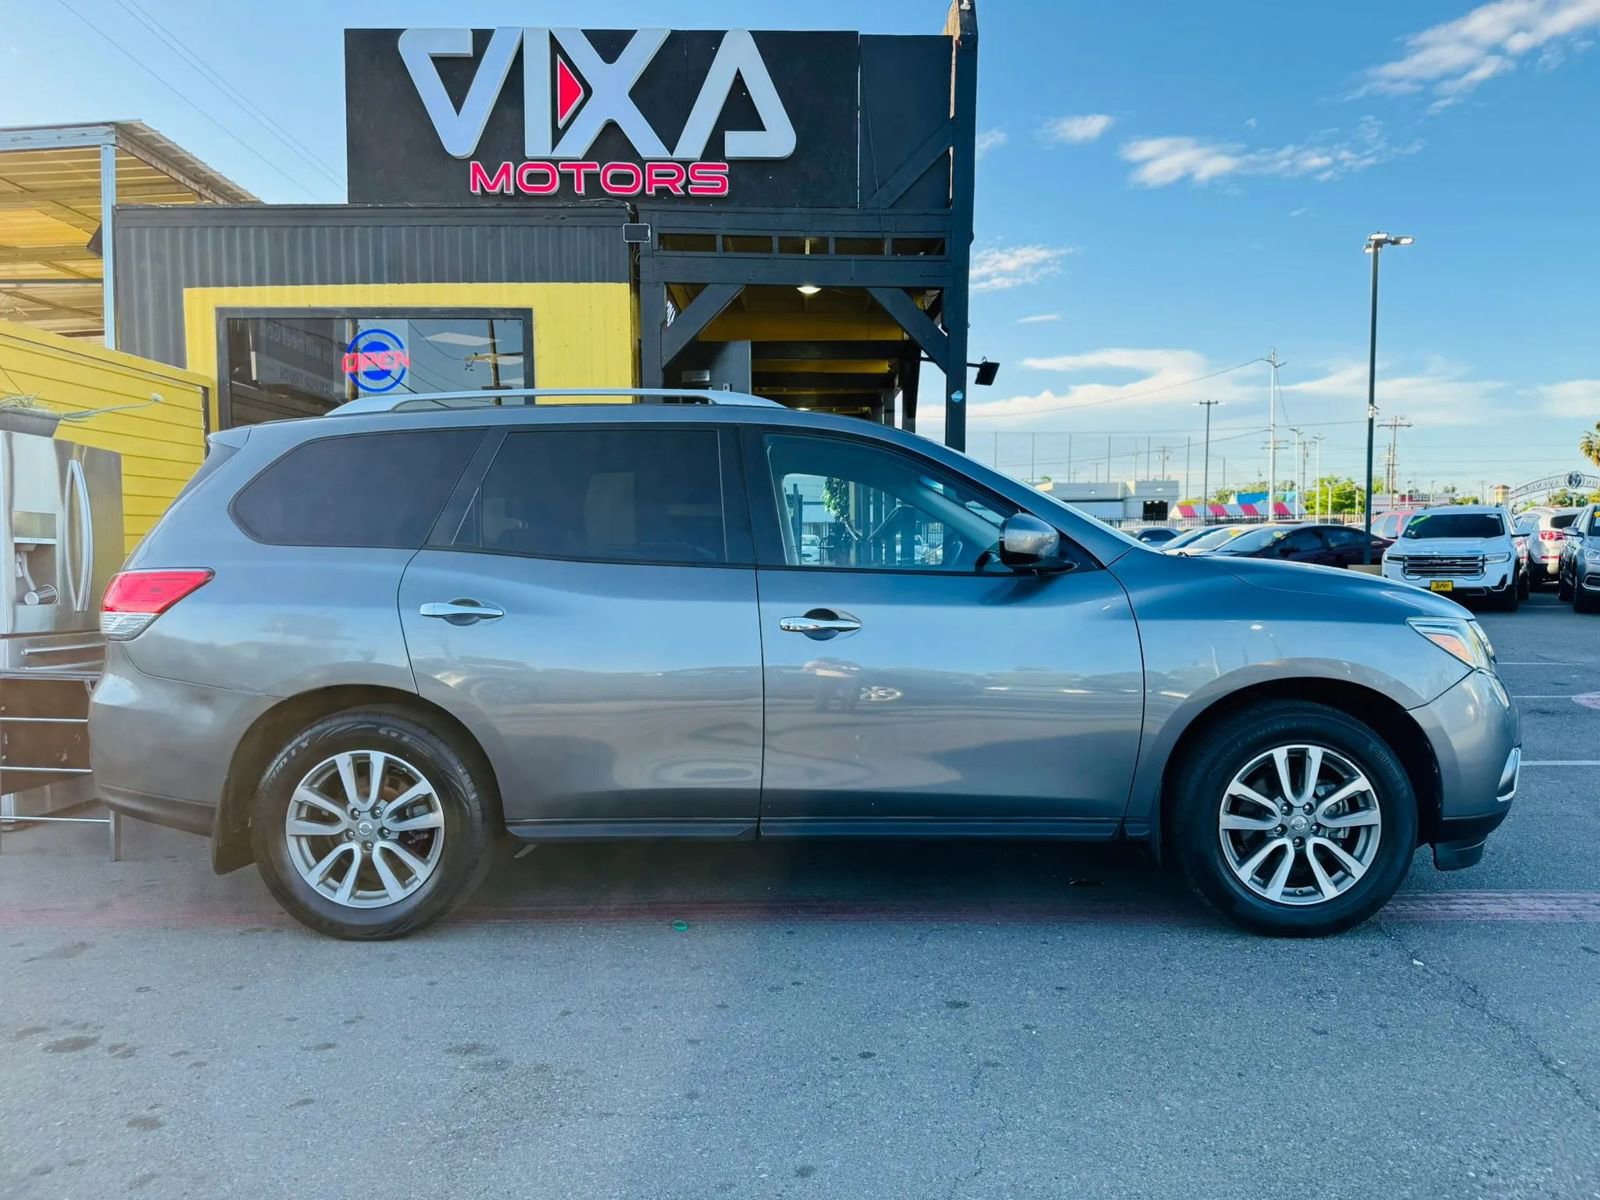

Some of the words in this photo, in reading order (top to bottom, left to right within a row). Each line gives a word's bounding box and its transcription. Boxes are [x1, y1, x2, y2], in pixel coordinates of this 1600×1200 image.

[398, 26, 797, 160] VIXA
[470, 161, 729, 197] MOTORS
[342, 350, 411, 373] OPEN
